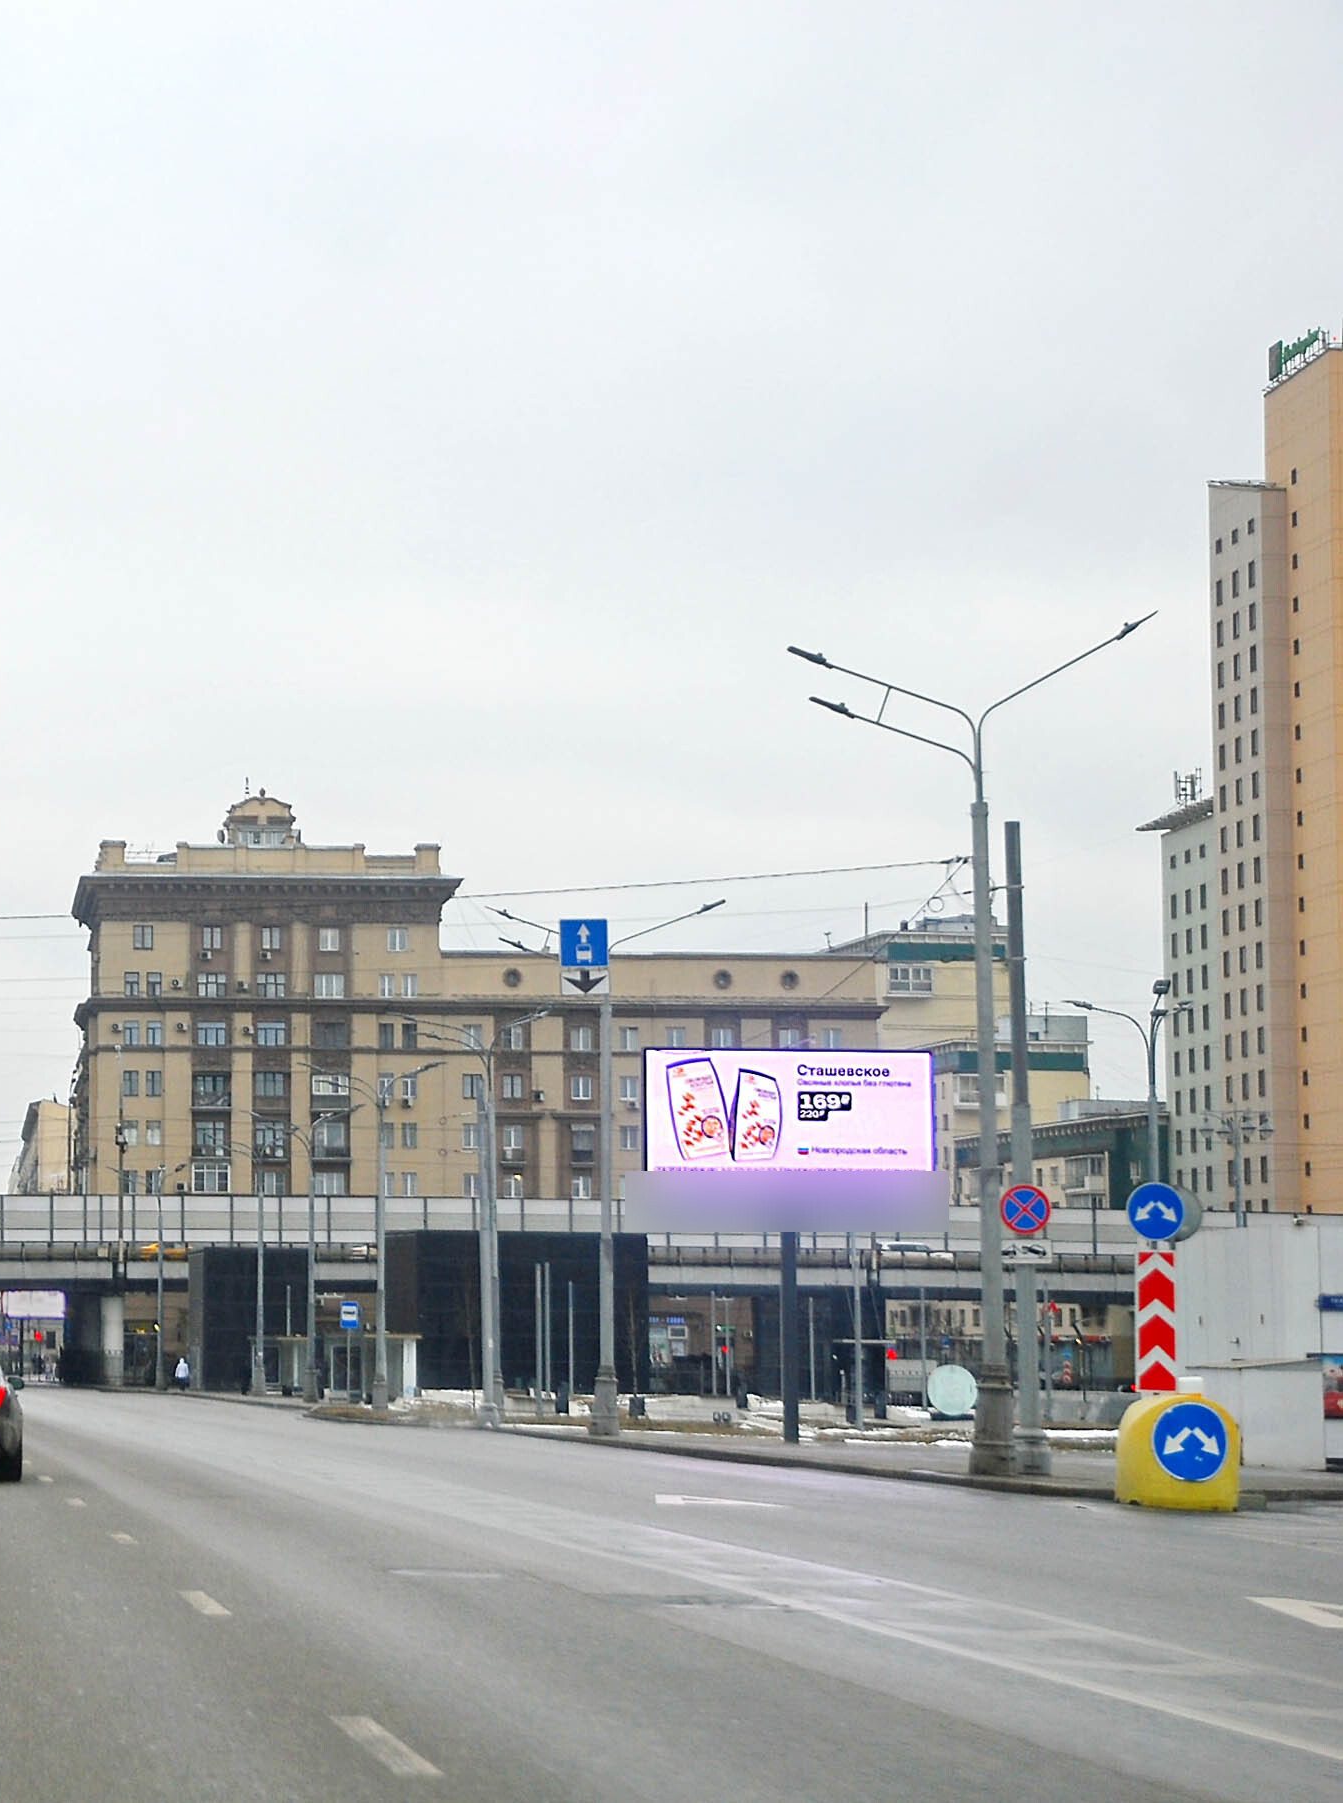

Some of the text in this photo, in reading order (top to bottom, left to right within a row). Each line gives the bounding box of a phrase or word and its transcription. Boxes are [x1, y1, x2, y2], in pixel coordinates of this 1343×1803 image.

[796, 1064, 890, 1077] Сташевское
[811, 1146, 908, 1156] Новгородская область
